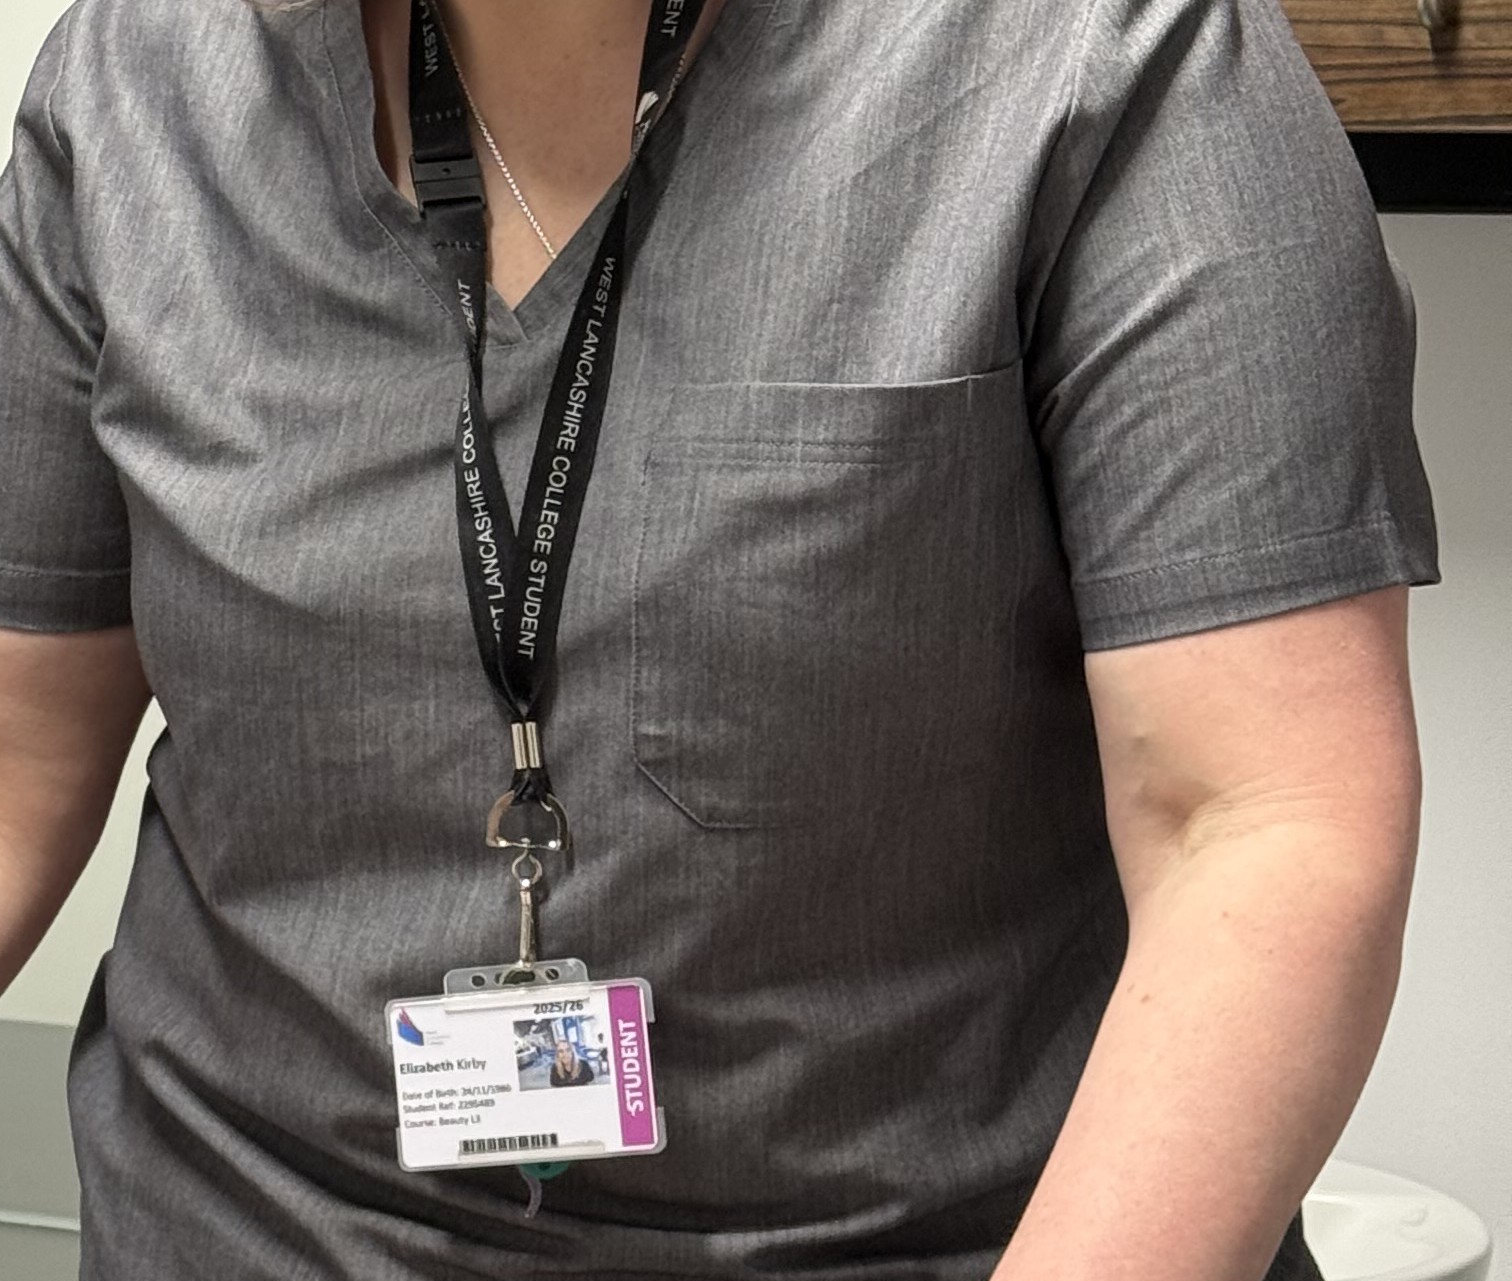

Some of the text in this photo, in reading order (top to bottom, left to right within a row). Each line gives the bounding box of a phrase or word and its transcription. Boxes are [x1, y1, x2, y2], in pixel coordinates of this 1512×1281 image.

[423, 23, 439, 78] WEST
[517, 256, 617, 661] WEST LANCASHIRE COLLEGE STUDENT
[463, 466, 506, 600] LANCASHIRE
[533, 999, 584, 1015] 2025/26
[399, 1057, 487, 1075] Elizabeth Kirby
[617, 1018, 645, 1117] STUDENT
[424, 1089, 434, 1099] of
